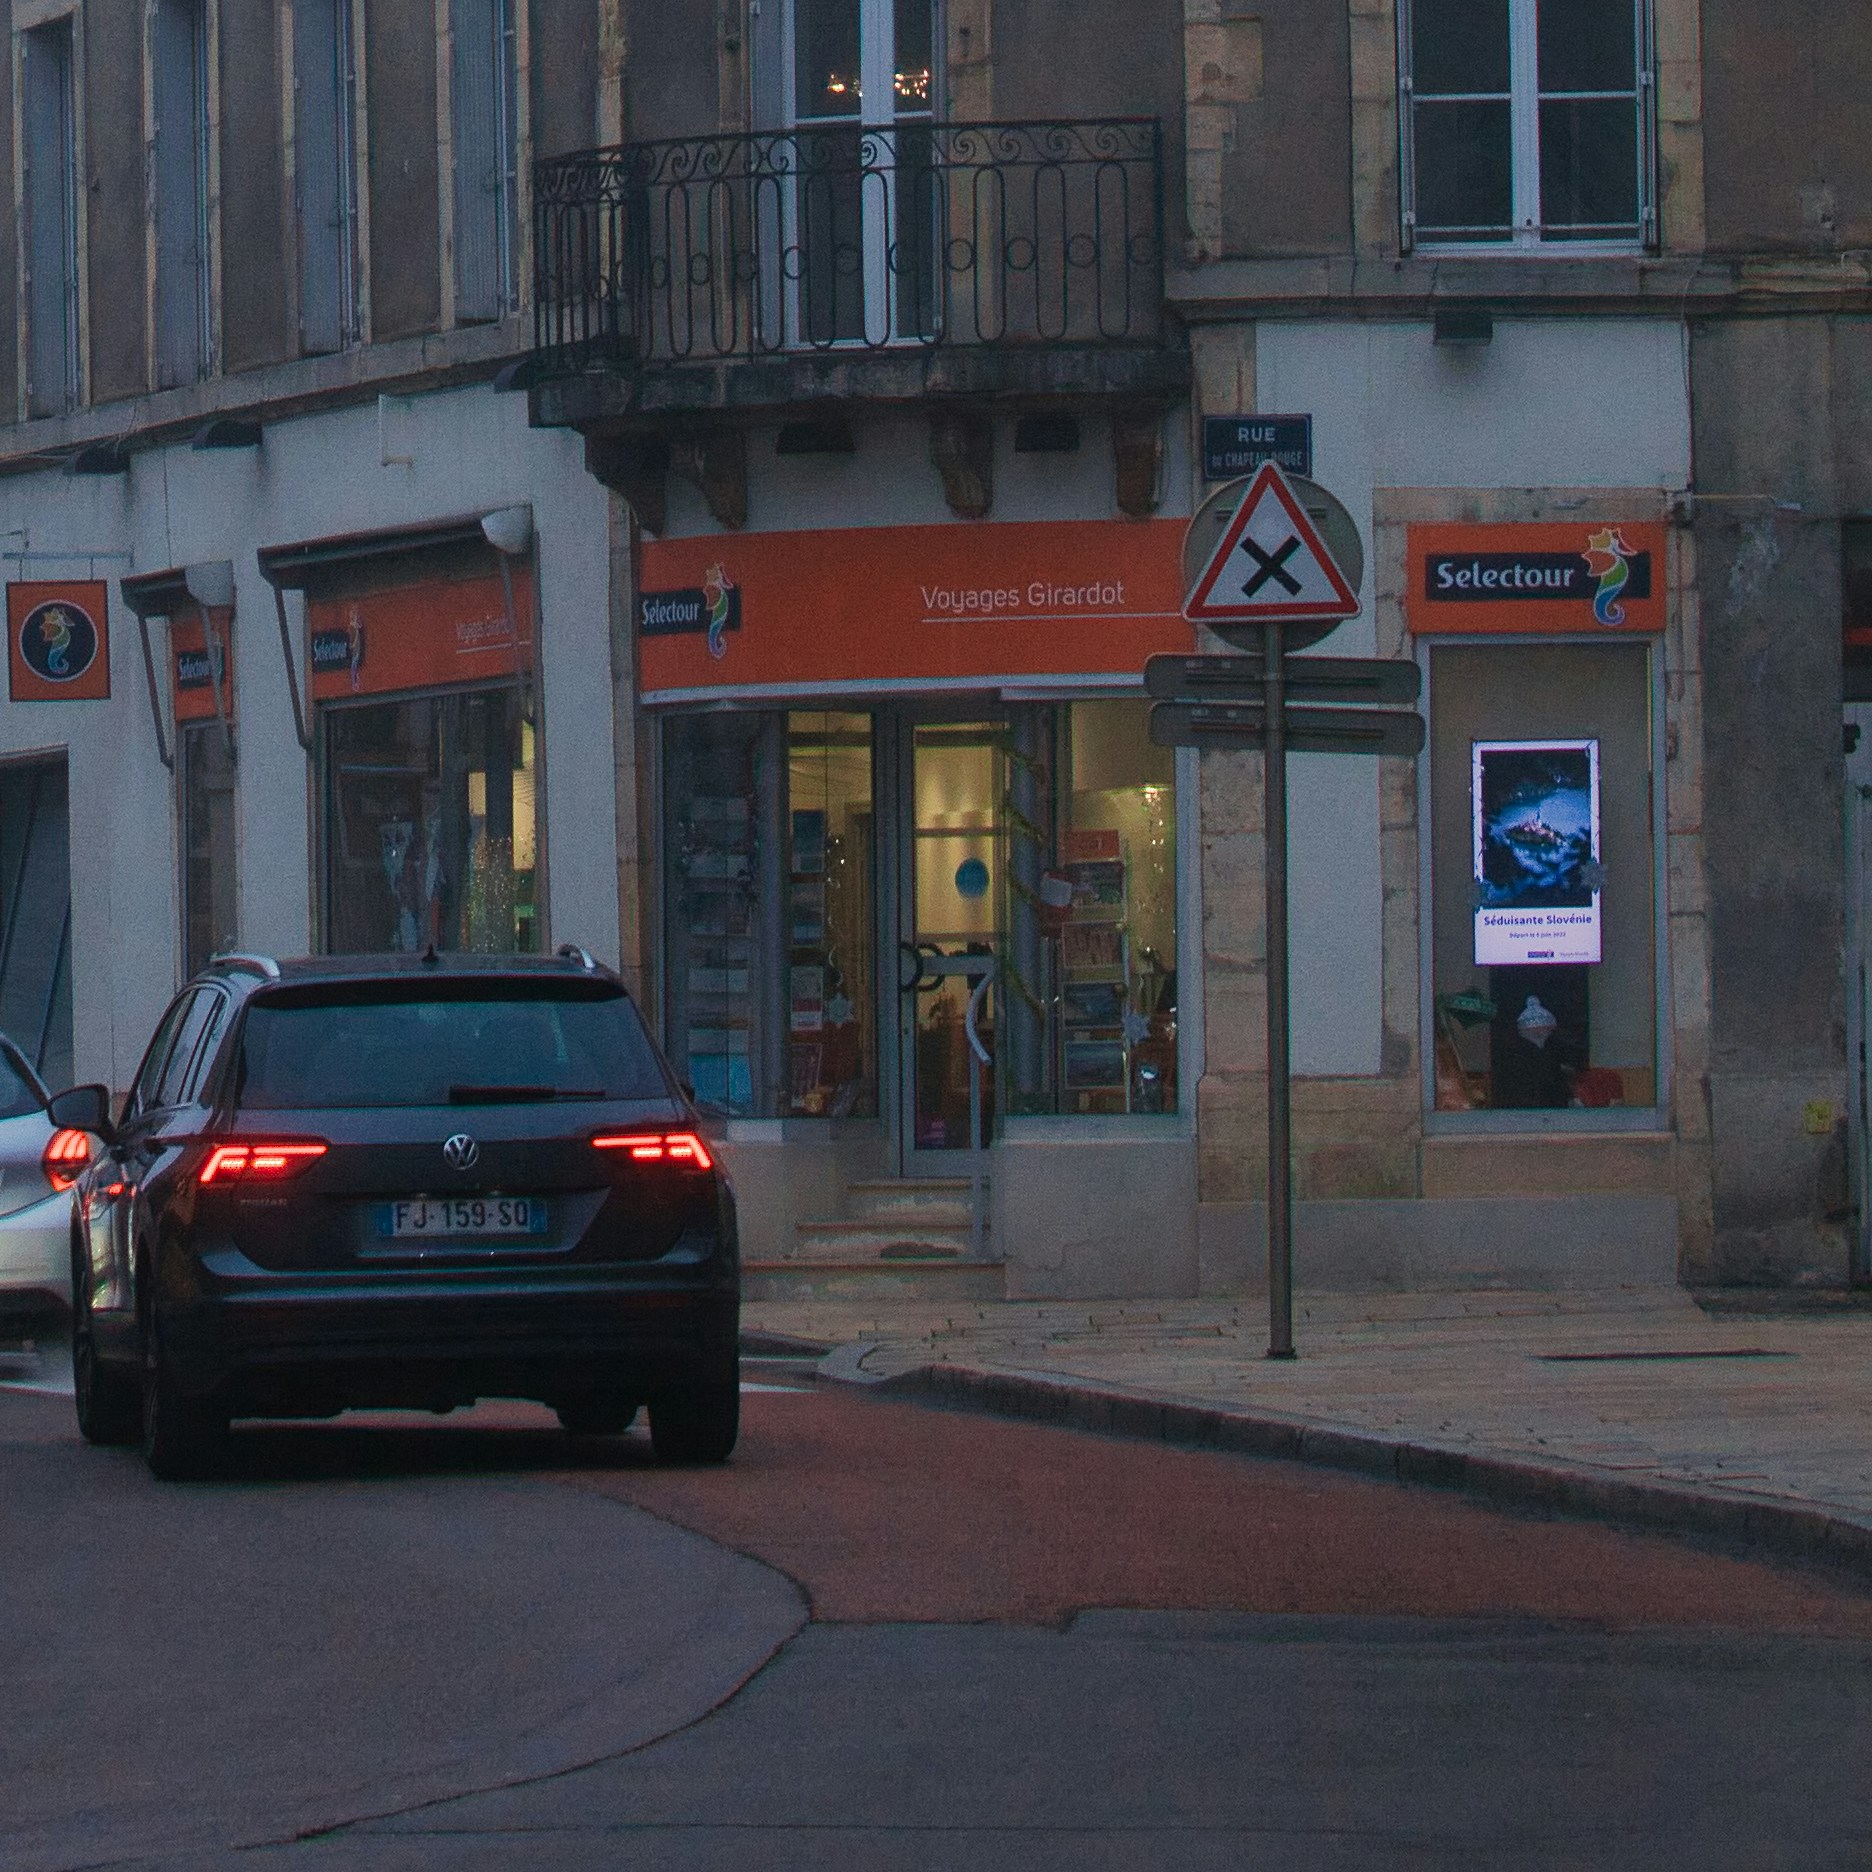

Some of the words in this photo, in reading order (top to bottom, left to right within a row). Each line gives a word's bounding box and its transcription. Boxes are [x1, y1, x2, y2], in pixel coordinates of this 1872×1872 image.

[1238, 427, 1276, 442] RUE
[1437, 560, 1575, 589] Selectour
[920, 585, 1020, 613] Voyages
[1027, 580, 1125, 606] Girardot
[642, 598, 701, 625] Selectour
[1484, 912, 1543, 926] Séduisante
[1546, 912, 1592, 925] Slovénie
